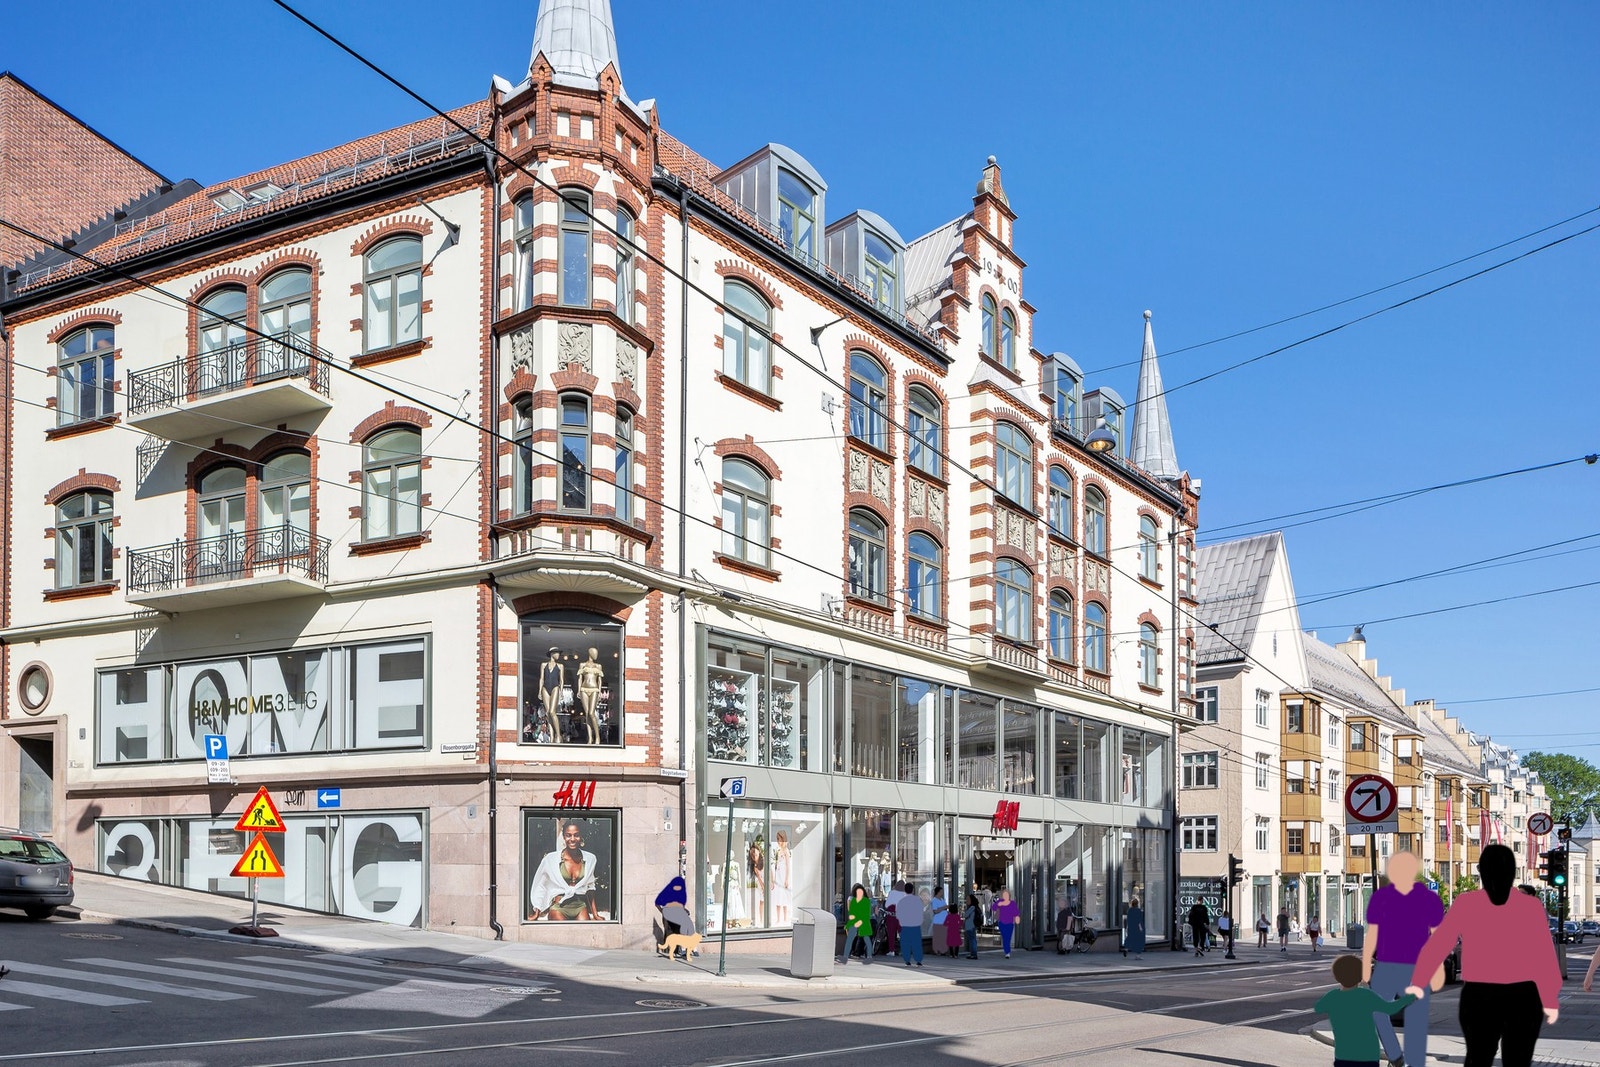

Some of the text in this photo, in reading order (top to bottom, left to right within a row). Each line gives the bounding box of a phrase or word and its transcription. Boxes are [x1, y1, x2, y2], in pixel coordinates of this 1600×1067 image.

[100, 638, 424, 762] HOME
[193, 698, 223, 718] H&M
[228, 694, 273, 716] HOME
[210, 738, 222, 757] P
[553, 779, 597, 808] H&M
[989, 799, 1020, 831] H&M
